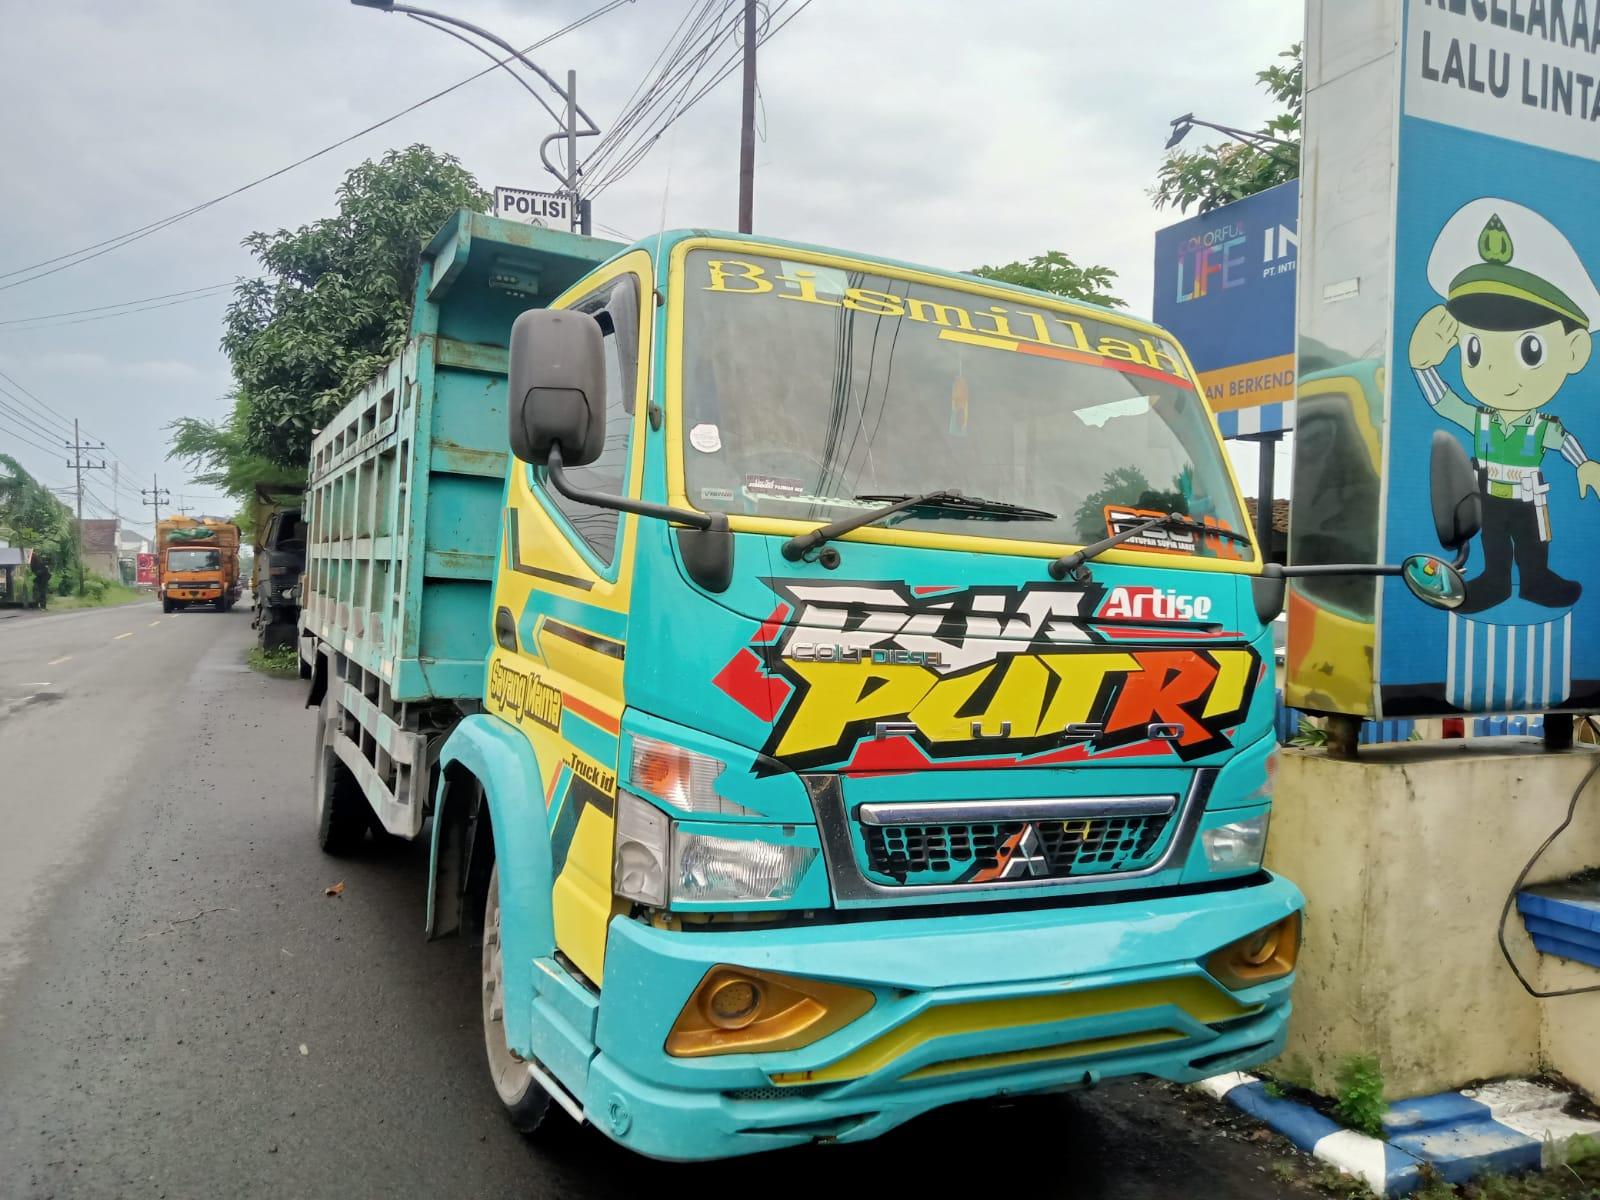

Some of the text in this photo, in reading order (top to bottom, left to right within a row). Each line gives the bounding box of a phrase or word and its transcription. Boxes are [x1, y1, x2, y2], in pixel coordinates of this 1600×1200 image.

[1421, 30, 1511, 99] LALU
[504, 195, 566, 219] POLISI
[1178, 221, 1246, 257] COLORFUL
[1176, 235, 1247, 304] LIFE
[701, 259, 1188, 380] Bismillah
[1105, 586, 1212, 620] Artise
[790, 642, 952, 669] COLT DIESEL
[490, 658, 528, 724] Sayang
[772, 649, 1254, 758] PUTRI
[874, 720, 1187, 742] FUSO
[600, 771, 615, 794] id
